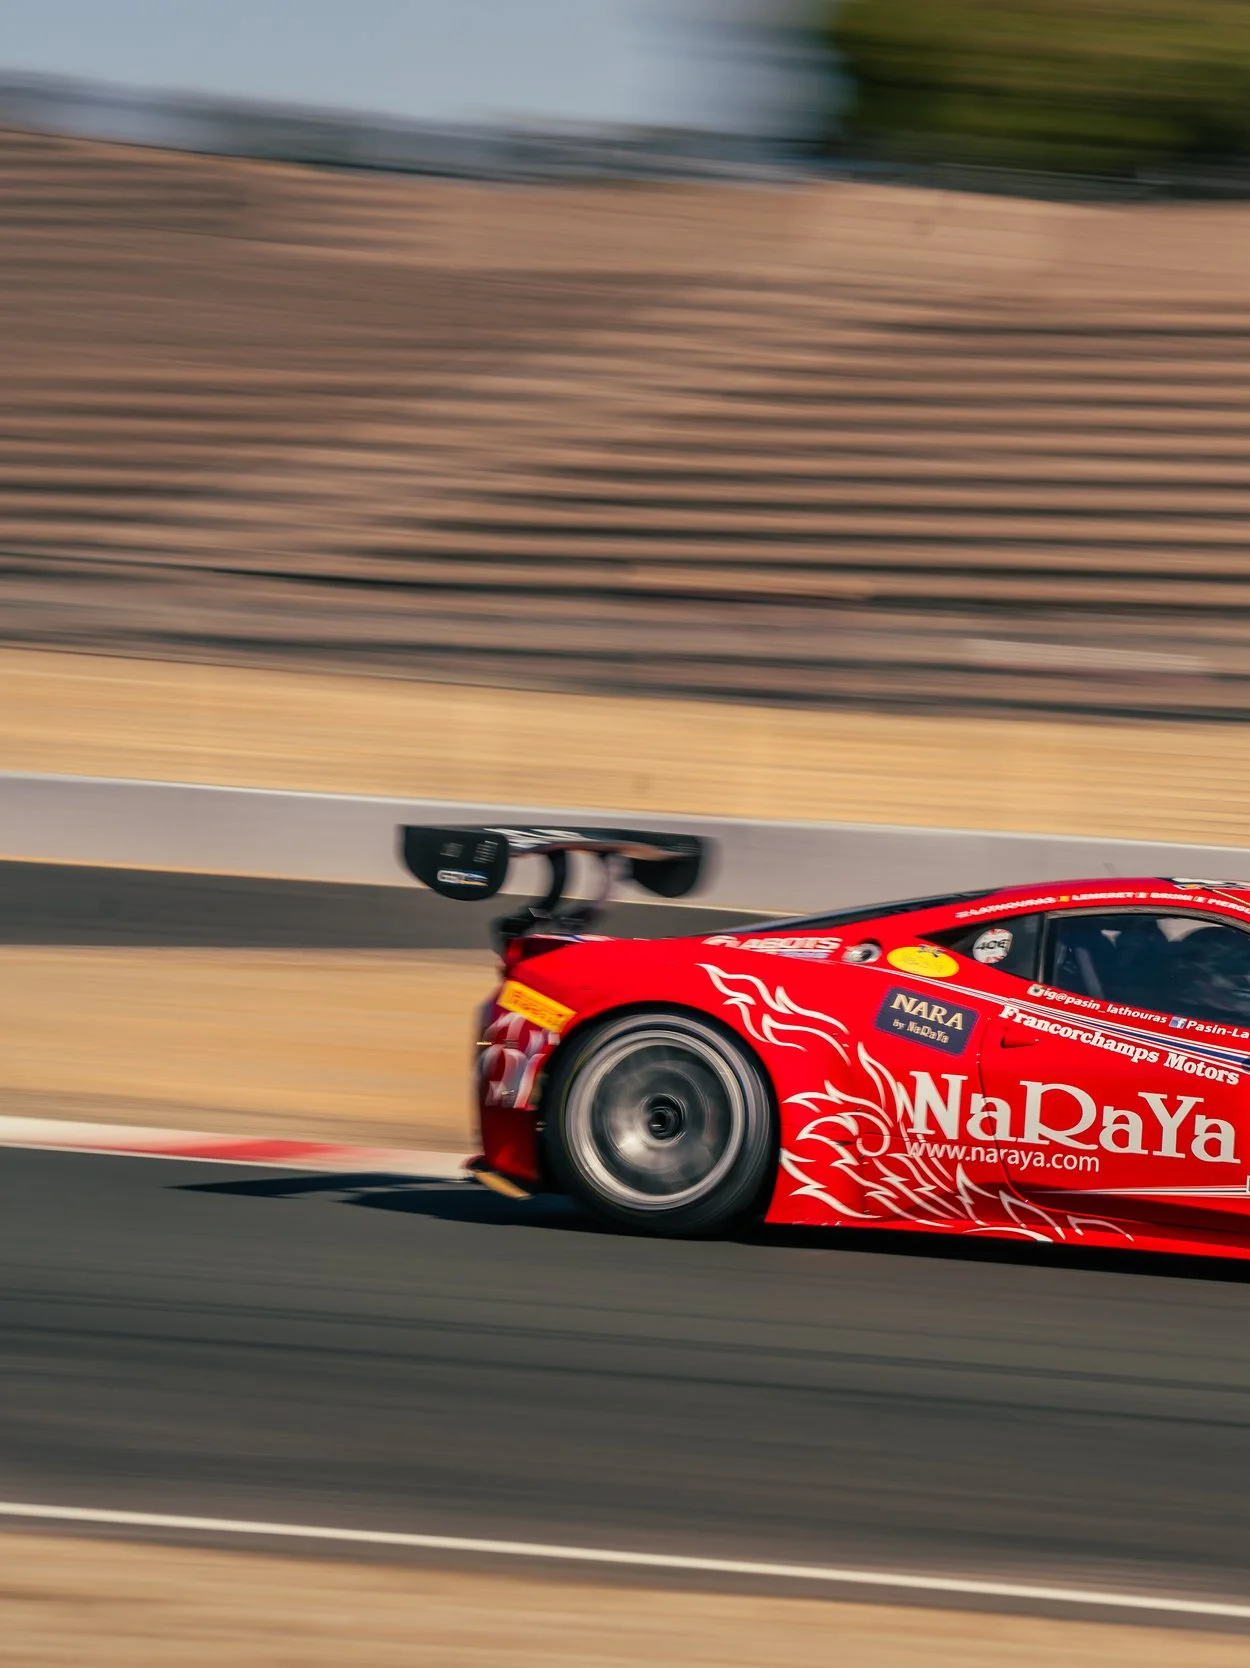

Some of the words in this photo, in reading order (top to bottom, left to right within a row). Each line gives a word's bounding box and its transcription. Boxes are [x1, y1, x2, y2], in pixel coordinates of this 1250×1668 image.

[890, 993, 964, 1030] NARA
[1043, 988, 1167, 1024] ig@pasin_lathouras
[892, 1019, 905, 1030] by
[998, 1004, 1159, 1063] Francorchamps
[1163, 1052, 1239, 1085] Motors
[906, 1071, 1241, 1164] NaRaYa
[906, 1141, 1100, 1173] www.naraya.com
